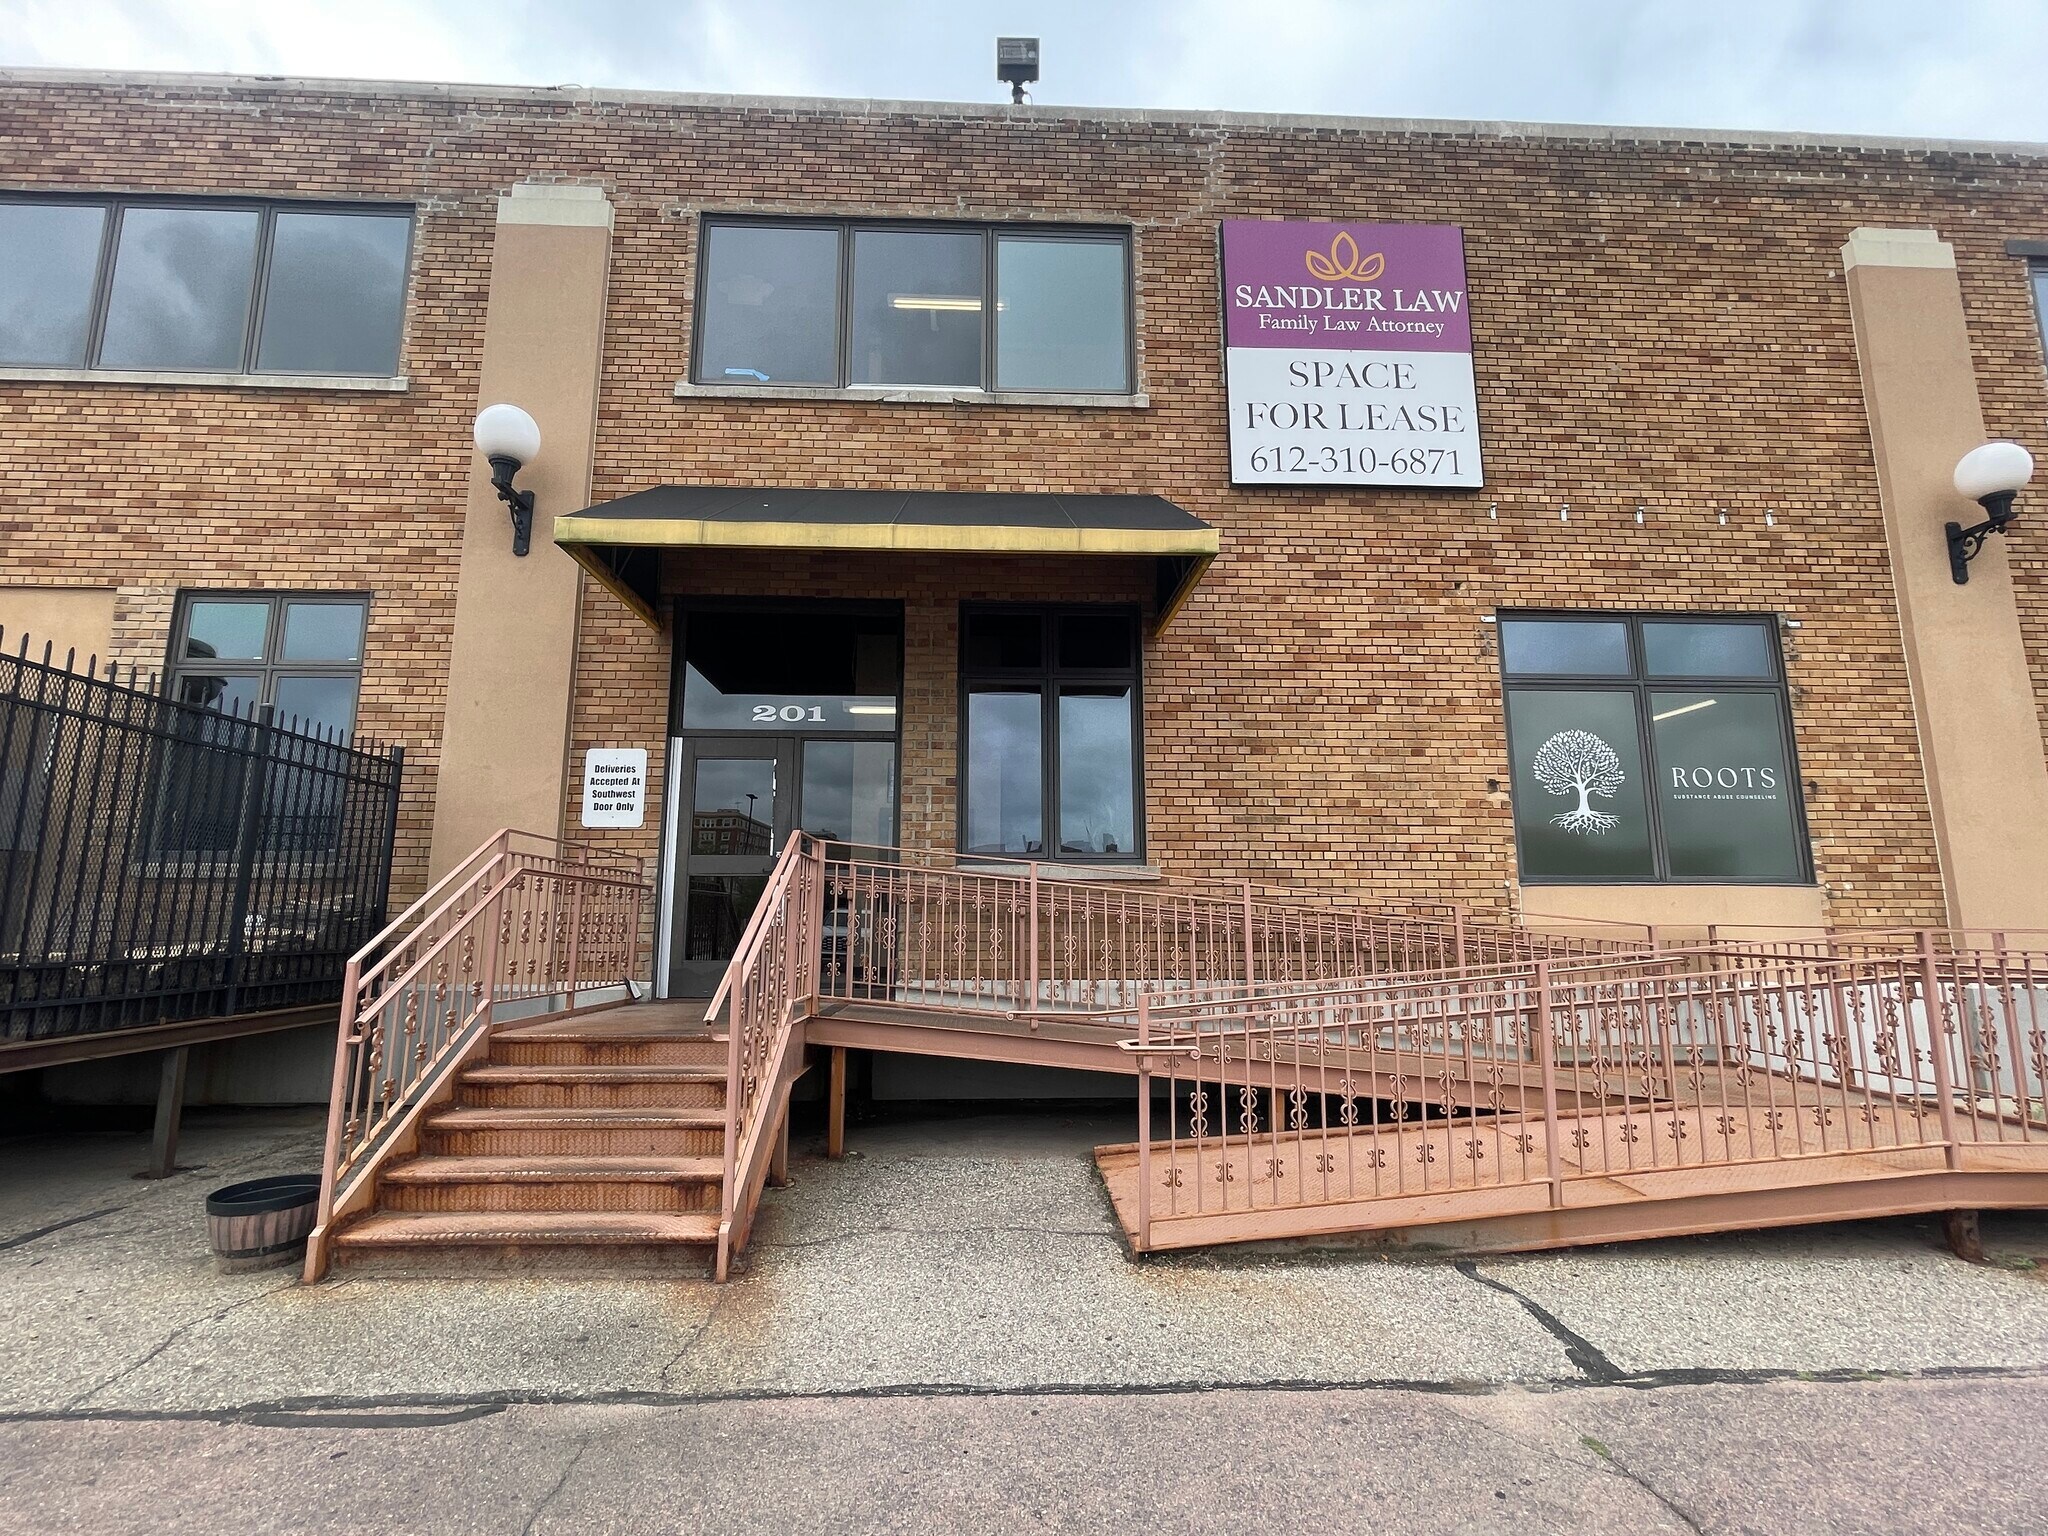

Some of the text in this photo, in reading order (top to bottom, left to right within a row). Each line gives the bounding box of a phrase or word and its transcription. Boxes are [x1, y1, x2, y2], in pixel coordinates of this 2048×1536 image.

[1235, 284, 1463, 313] SANDLER LAW
[1258, 313, 1445, 338] Family Law Attorney
[1289, 360, 1417, 390] SPACE
[1246, 402, 1466, 433] FOR LEASE
[1250, 445, 1464, 476] 612-310-6871
[752, 704, 827, 723] 201
[594, 764, 636, 774] Deliveries
[1671, 766, 1776, 789] ROOTS
[589, 776, 641, 787] Accepted At
[591, 789, 636, 799] Southwest
[593, 801, 635, 812] Door Only
